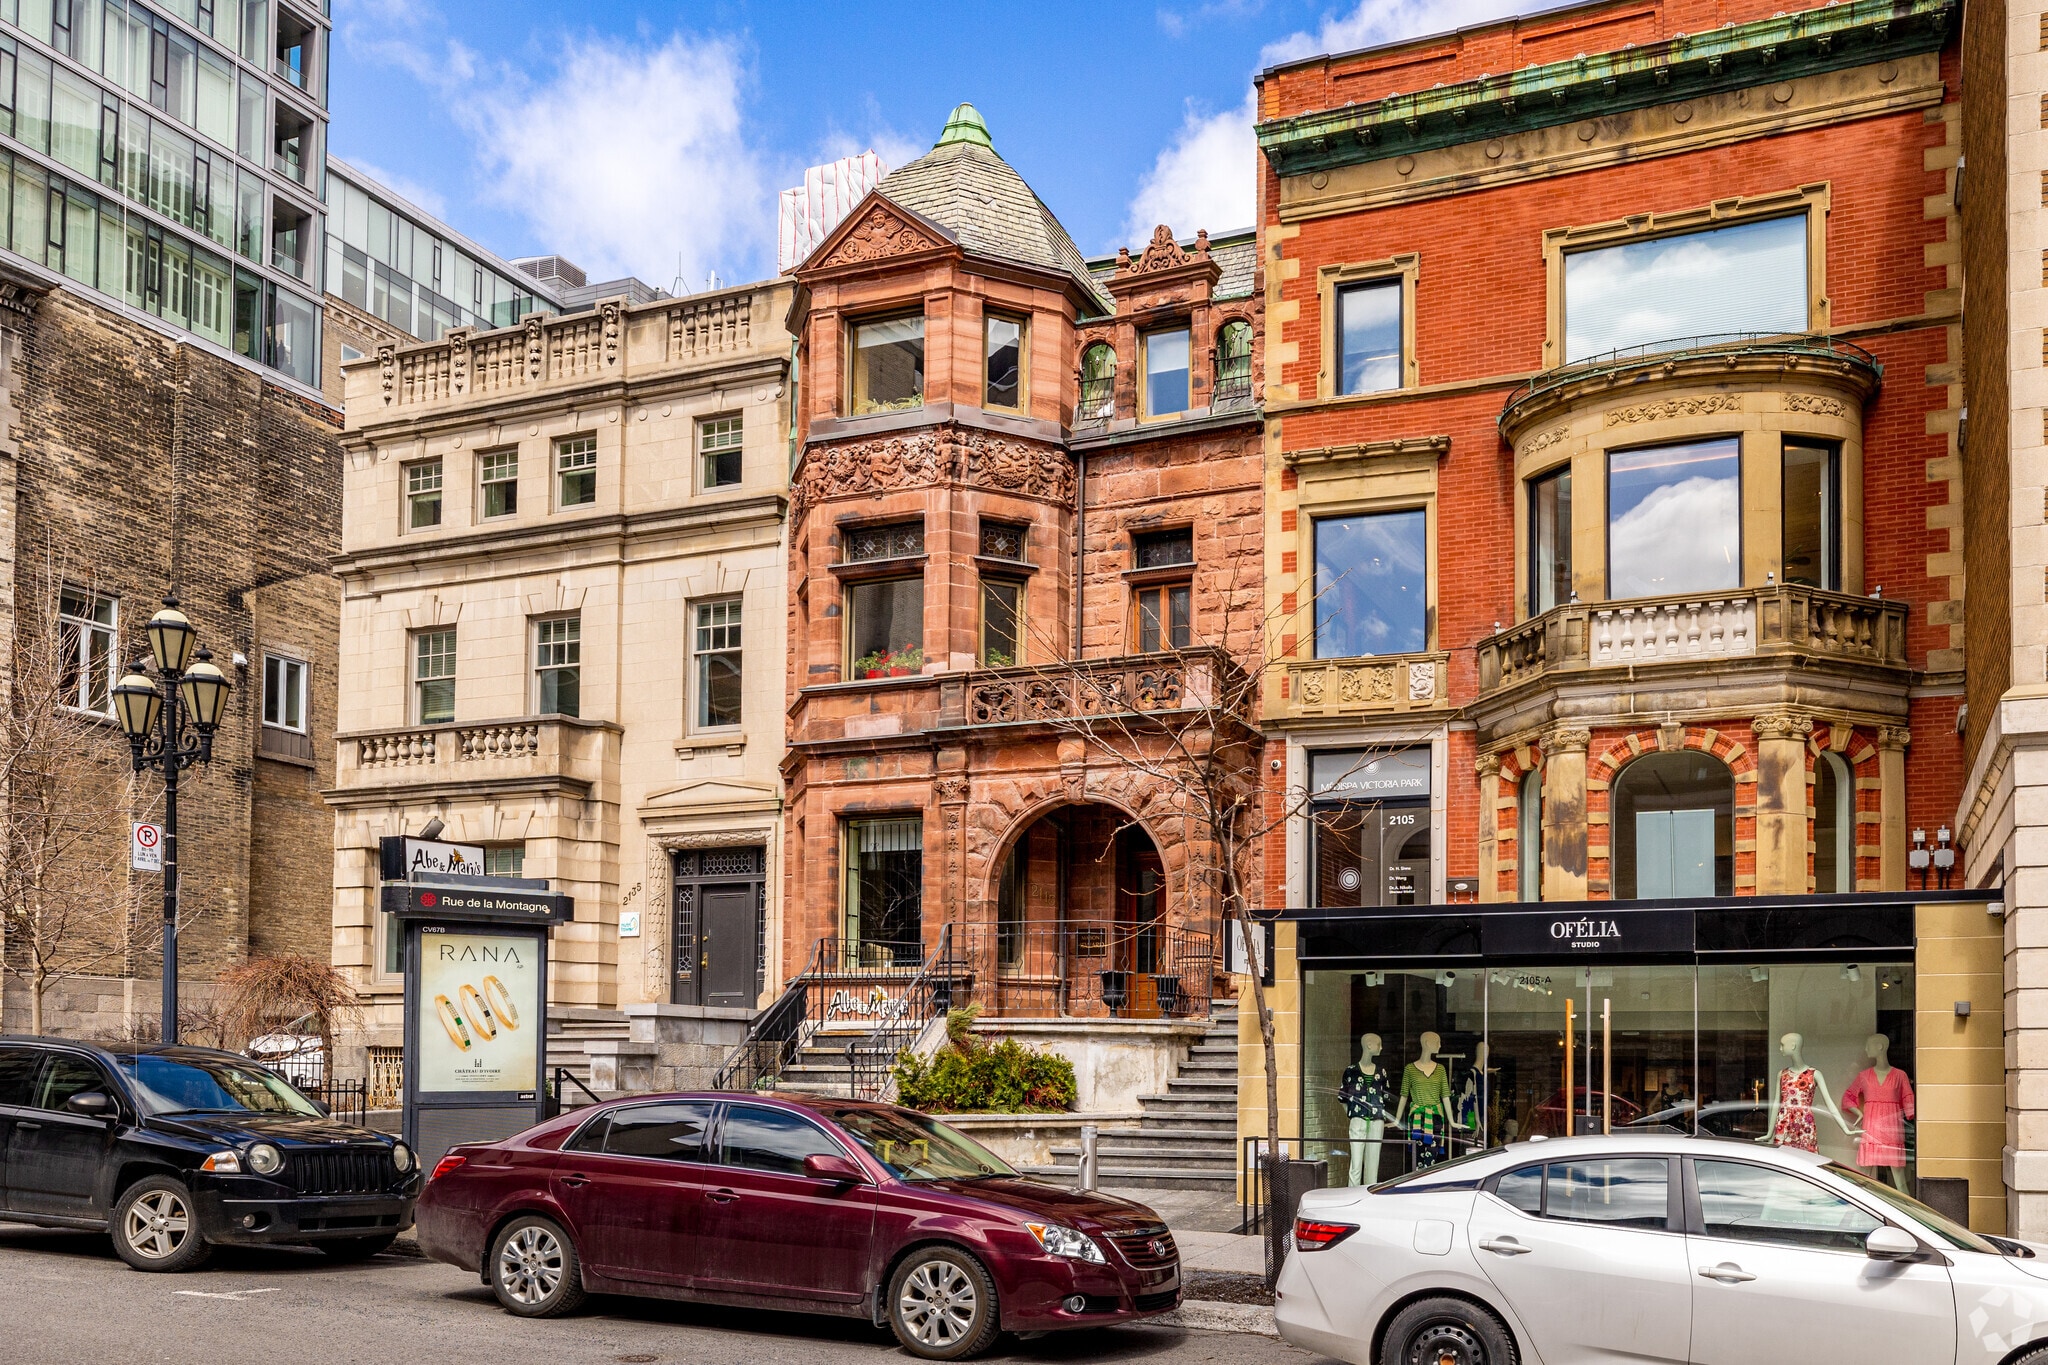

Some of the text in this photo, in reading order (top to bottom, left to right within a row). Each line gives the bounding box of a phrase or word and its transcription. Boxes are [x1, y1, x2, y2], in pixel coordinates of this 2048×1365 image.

[1359, 779, 1399, 790] VICTORIA
[1400, 778, 1423, 788] PARK
[1389, 815, 1415, 825] 2105
[411, 848, 439, 872] Abe
[439, 862, 445, 872] &
[622, 882, 642, 906] 2135
[442, 896, 549, 914] Rue de la Montagne
[1550, 916, 1621, 939] OFÉLIA
[440, 944, 520, 963] RANA
[1519, 976, 1552, 985] 2105-A
